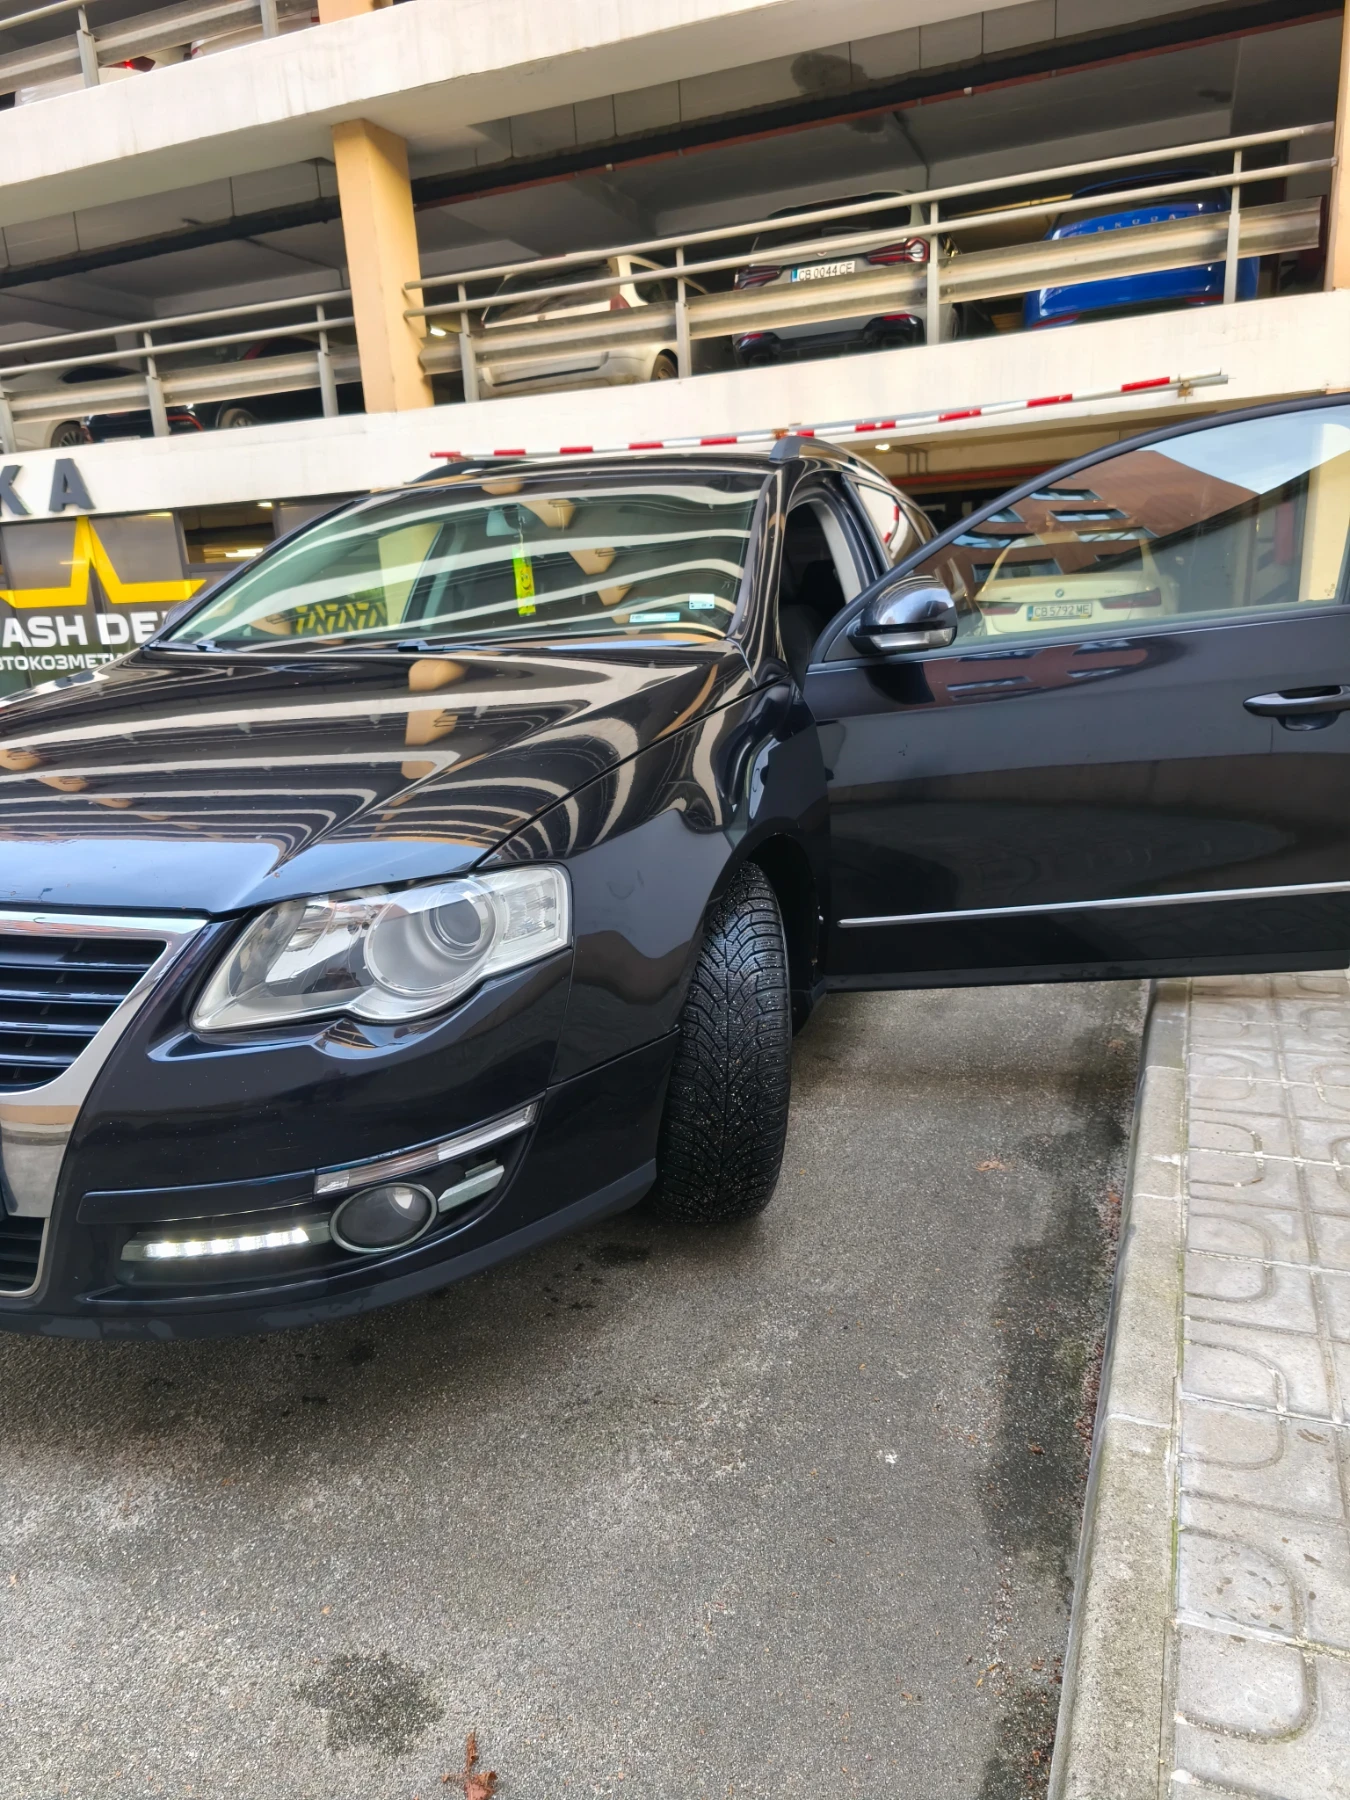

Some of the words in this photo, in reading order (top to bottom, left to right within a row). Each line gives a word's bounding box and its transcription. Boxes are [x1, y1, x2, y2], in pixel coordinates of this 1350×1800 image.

[814, 265, 838, 278] 0044
[1034, 606, 1048, 617] CB
[1050, 604, 1074, 616] 5792
[1076, 604, 1090, 615] ME
[96, 610, 165, 645] DE
